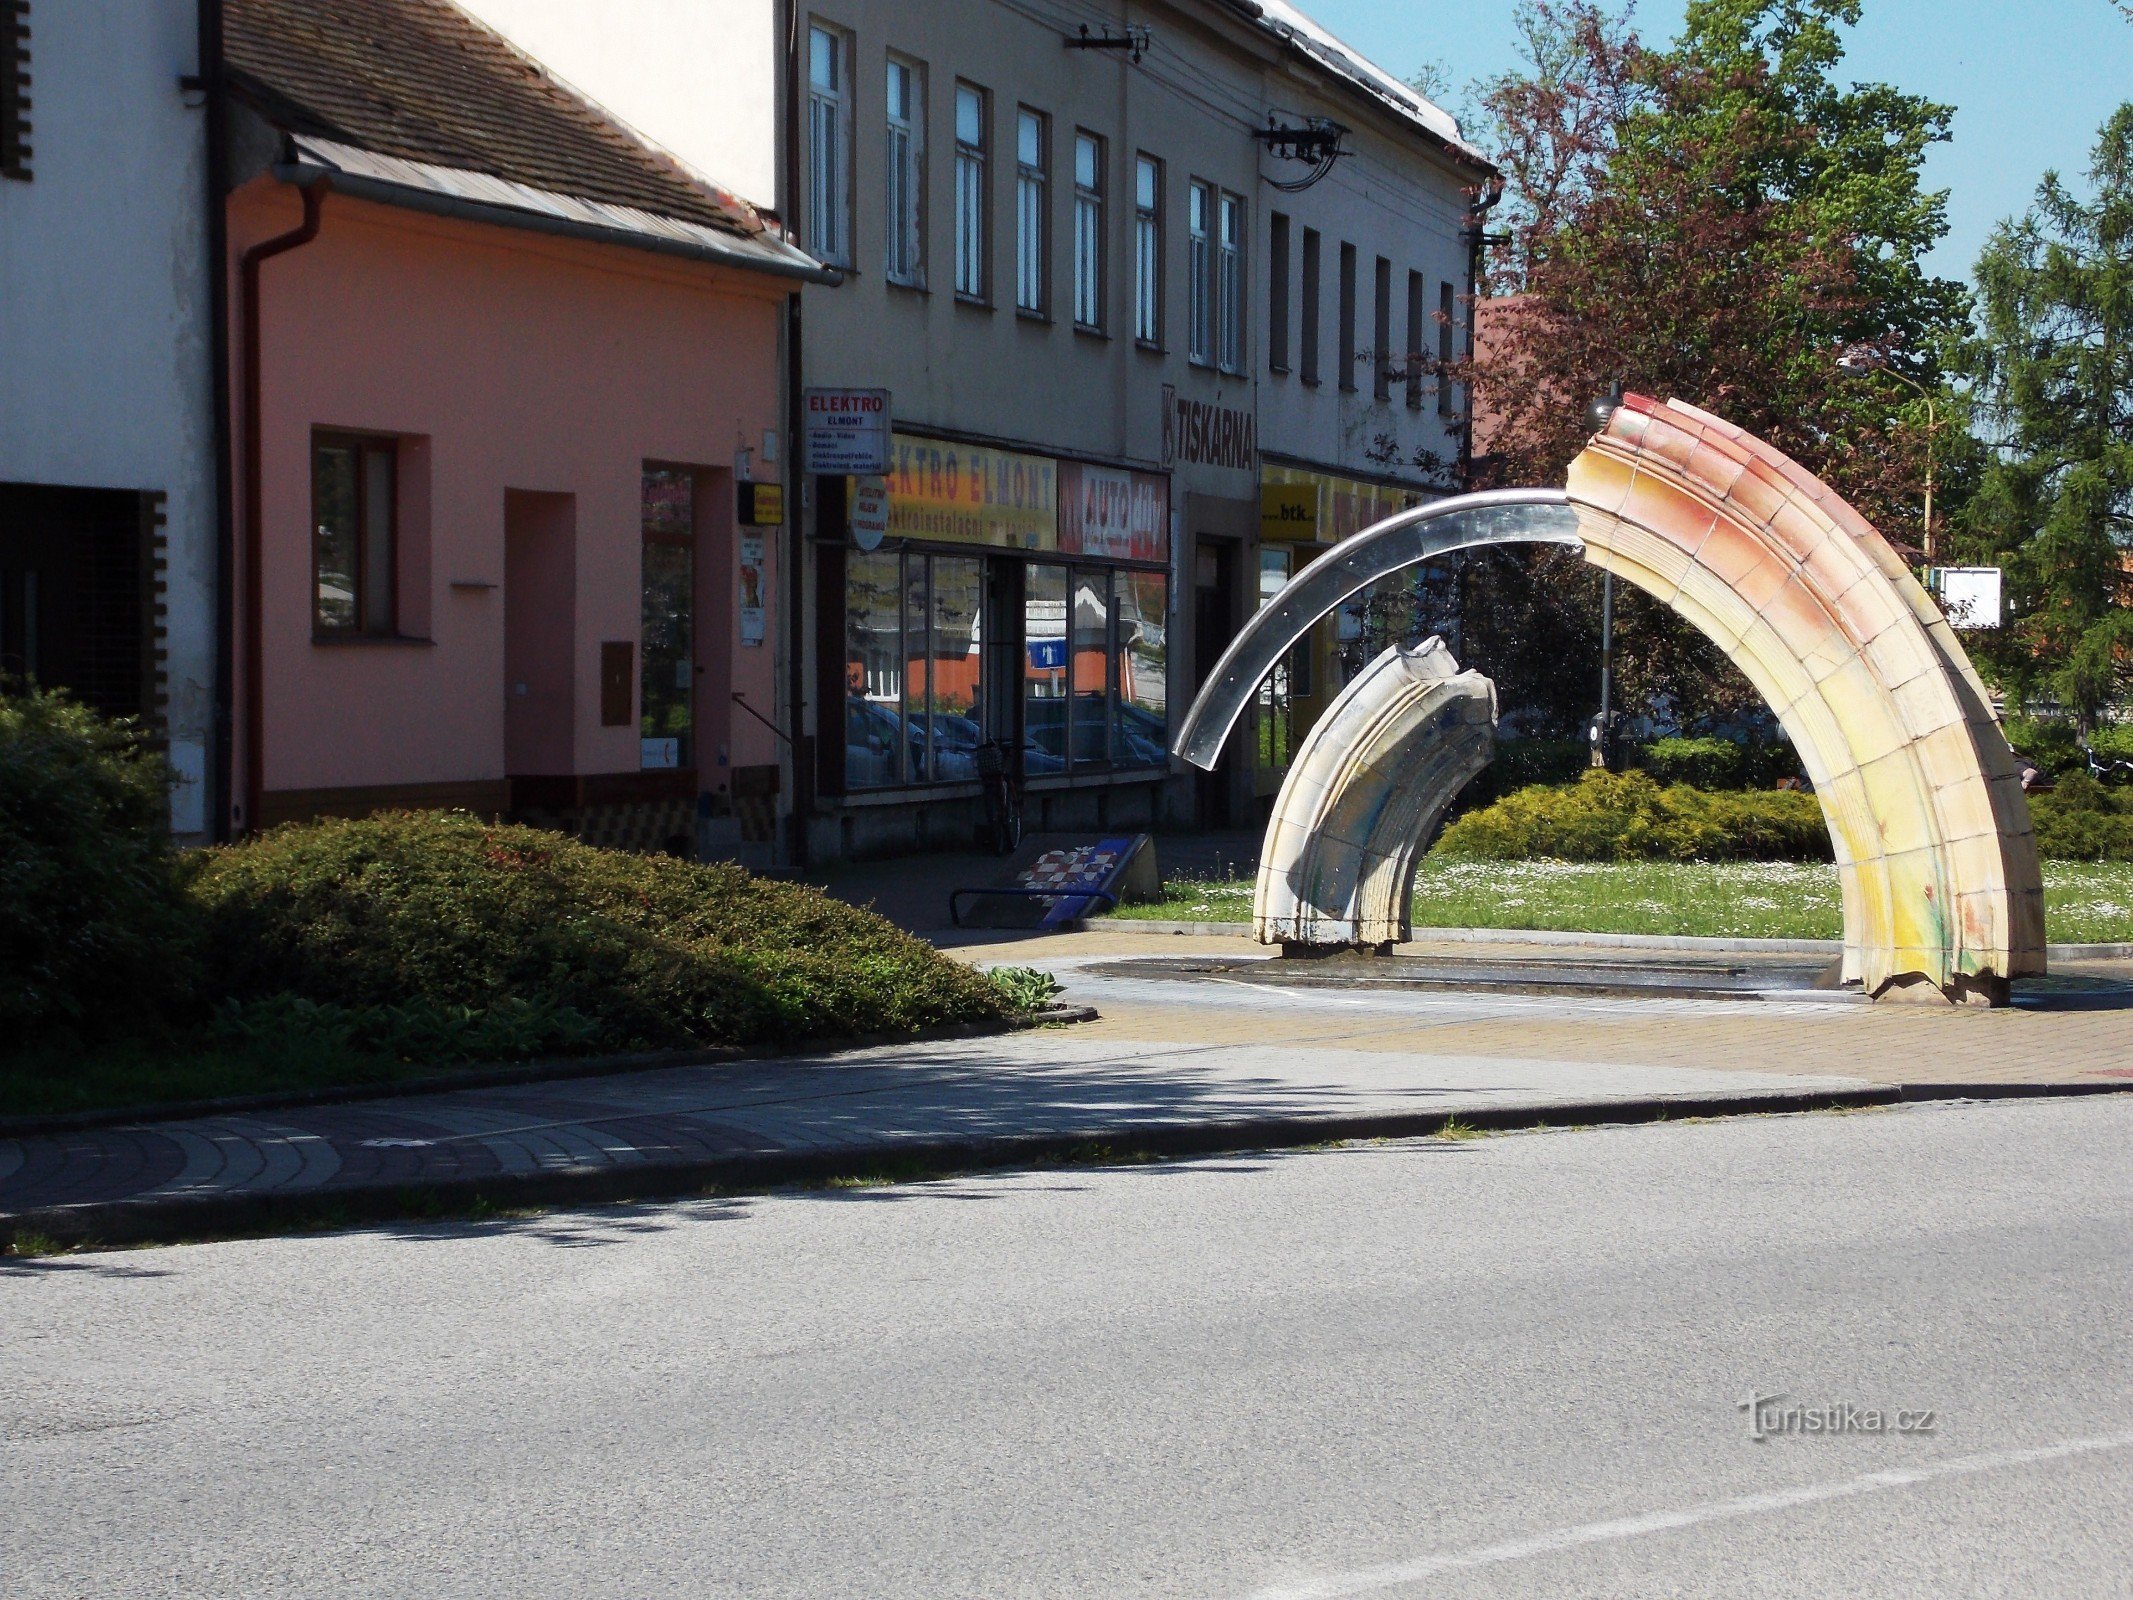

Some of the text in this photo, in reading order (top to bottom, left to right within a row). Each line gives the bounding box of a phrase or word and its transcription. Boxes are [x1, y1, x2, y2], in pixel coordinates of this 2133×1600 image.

[810, 396, 882, 411] ELEKTRO
[827, 416, 863, 426] ELMONT
[1177, 390, 1252, 471] TISKÁRNA
[970, 454, 1051, 512] ELMONT
[1086, 478, 1129, 529] AUTO
